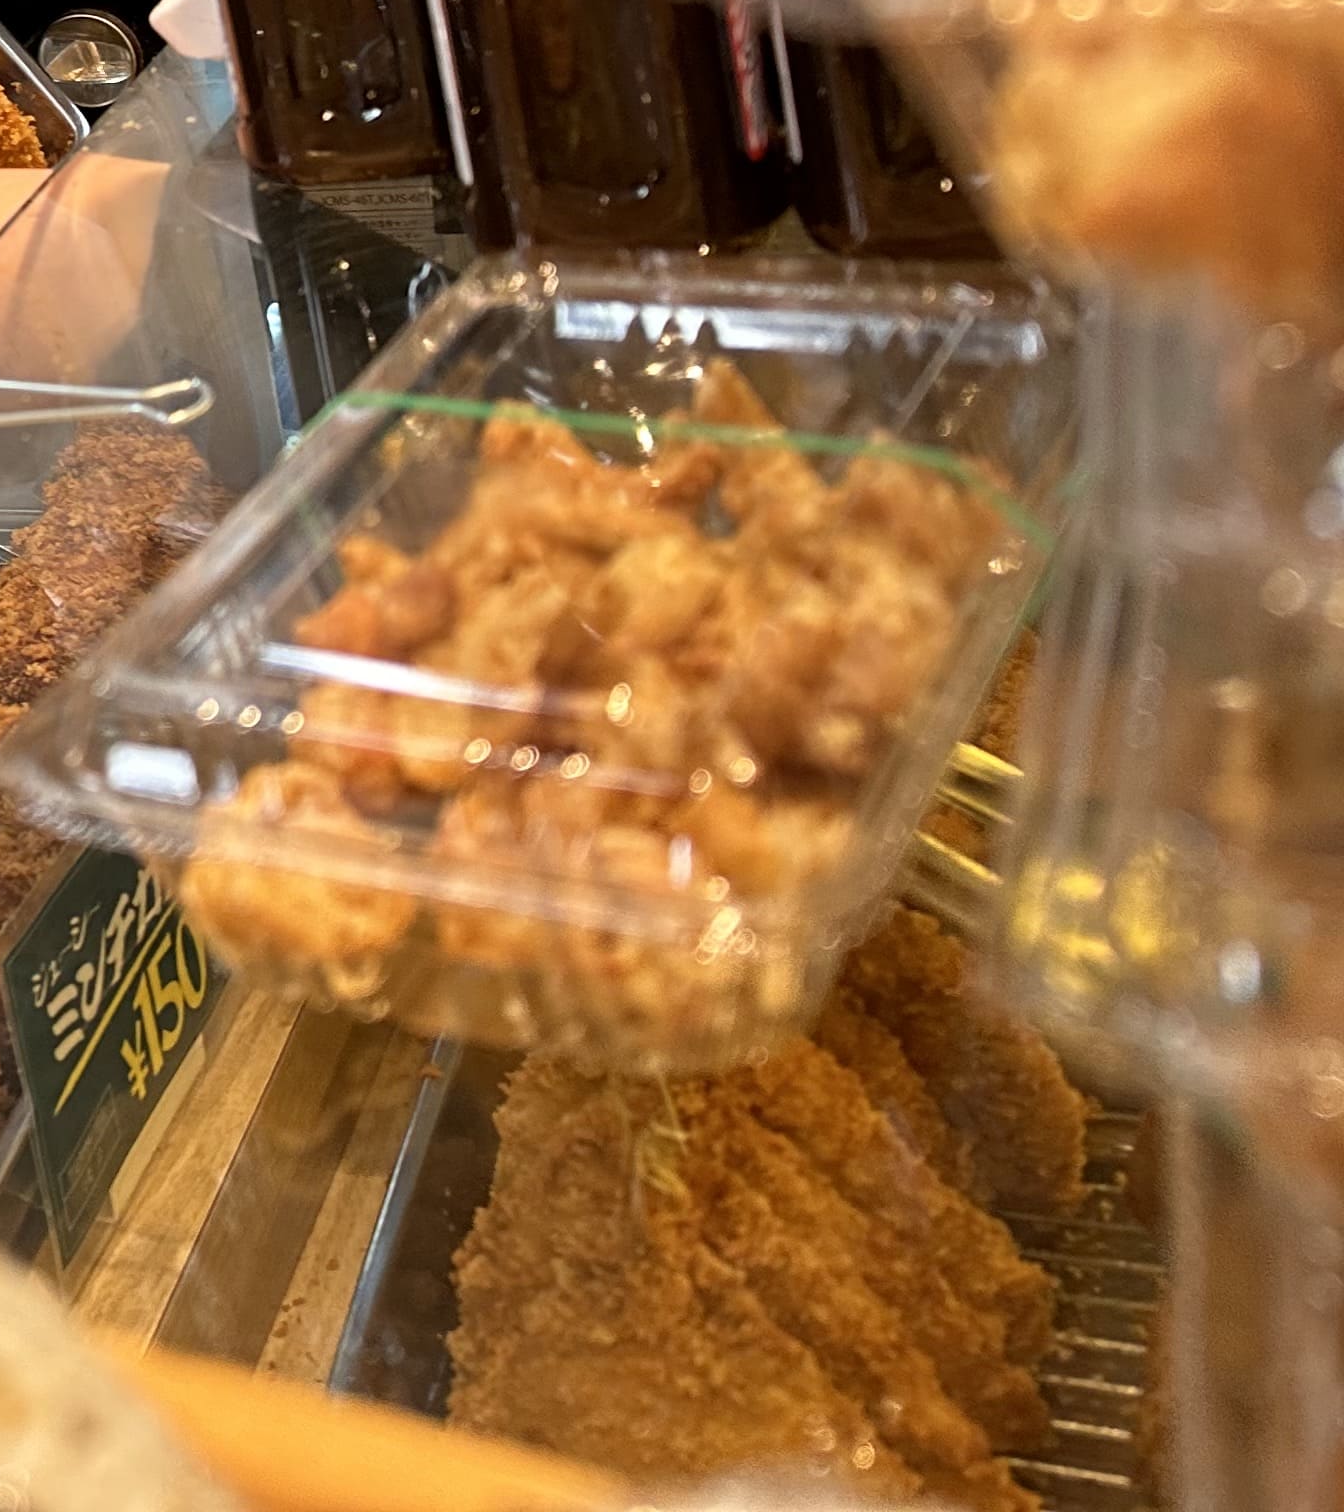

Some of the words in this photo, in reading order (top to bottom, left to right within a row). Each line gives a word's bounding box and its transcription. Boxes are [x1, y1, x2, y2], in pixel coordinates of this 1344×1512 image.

[45, 866, 174, 1064] ミンチカ
[119, 918, 209, 1101] ¥150
